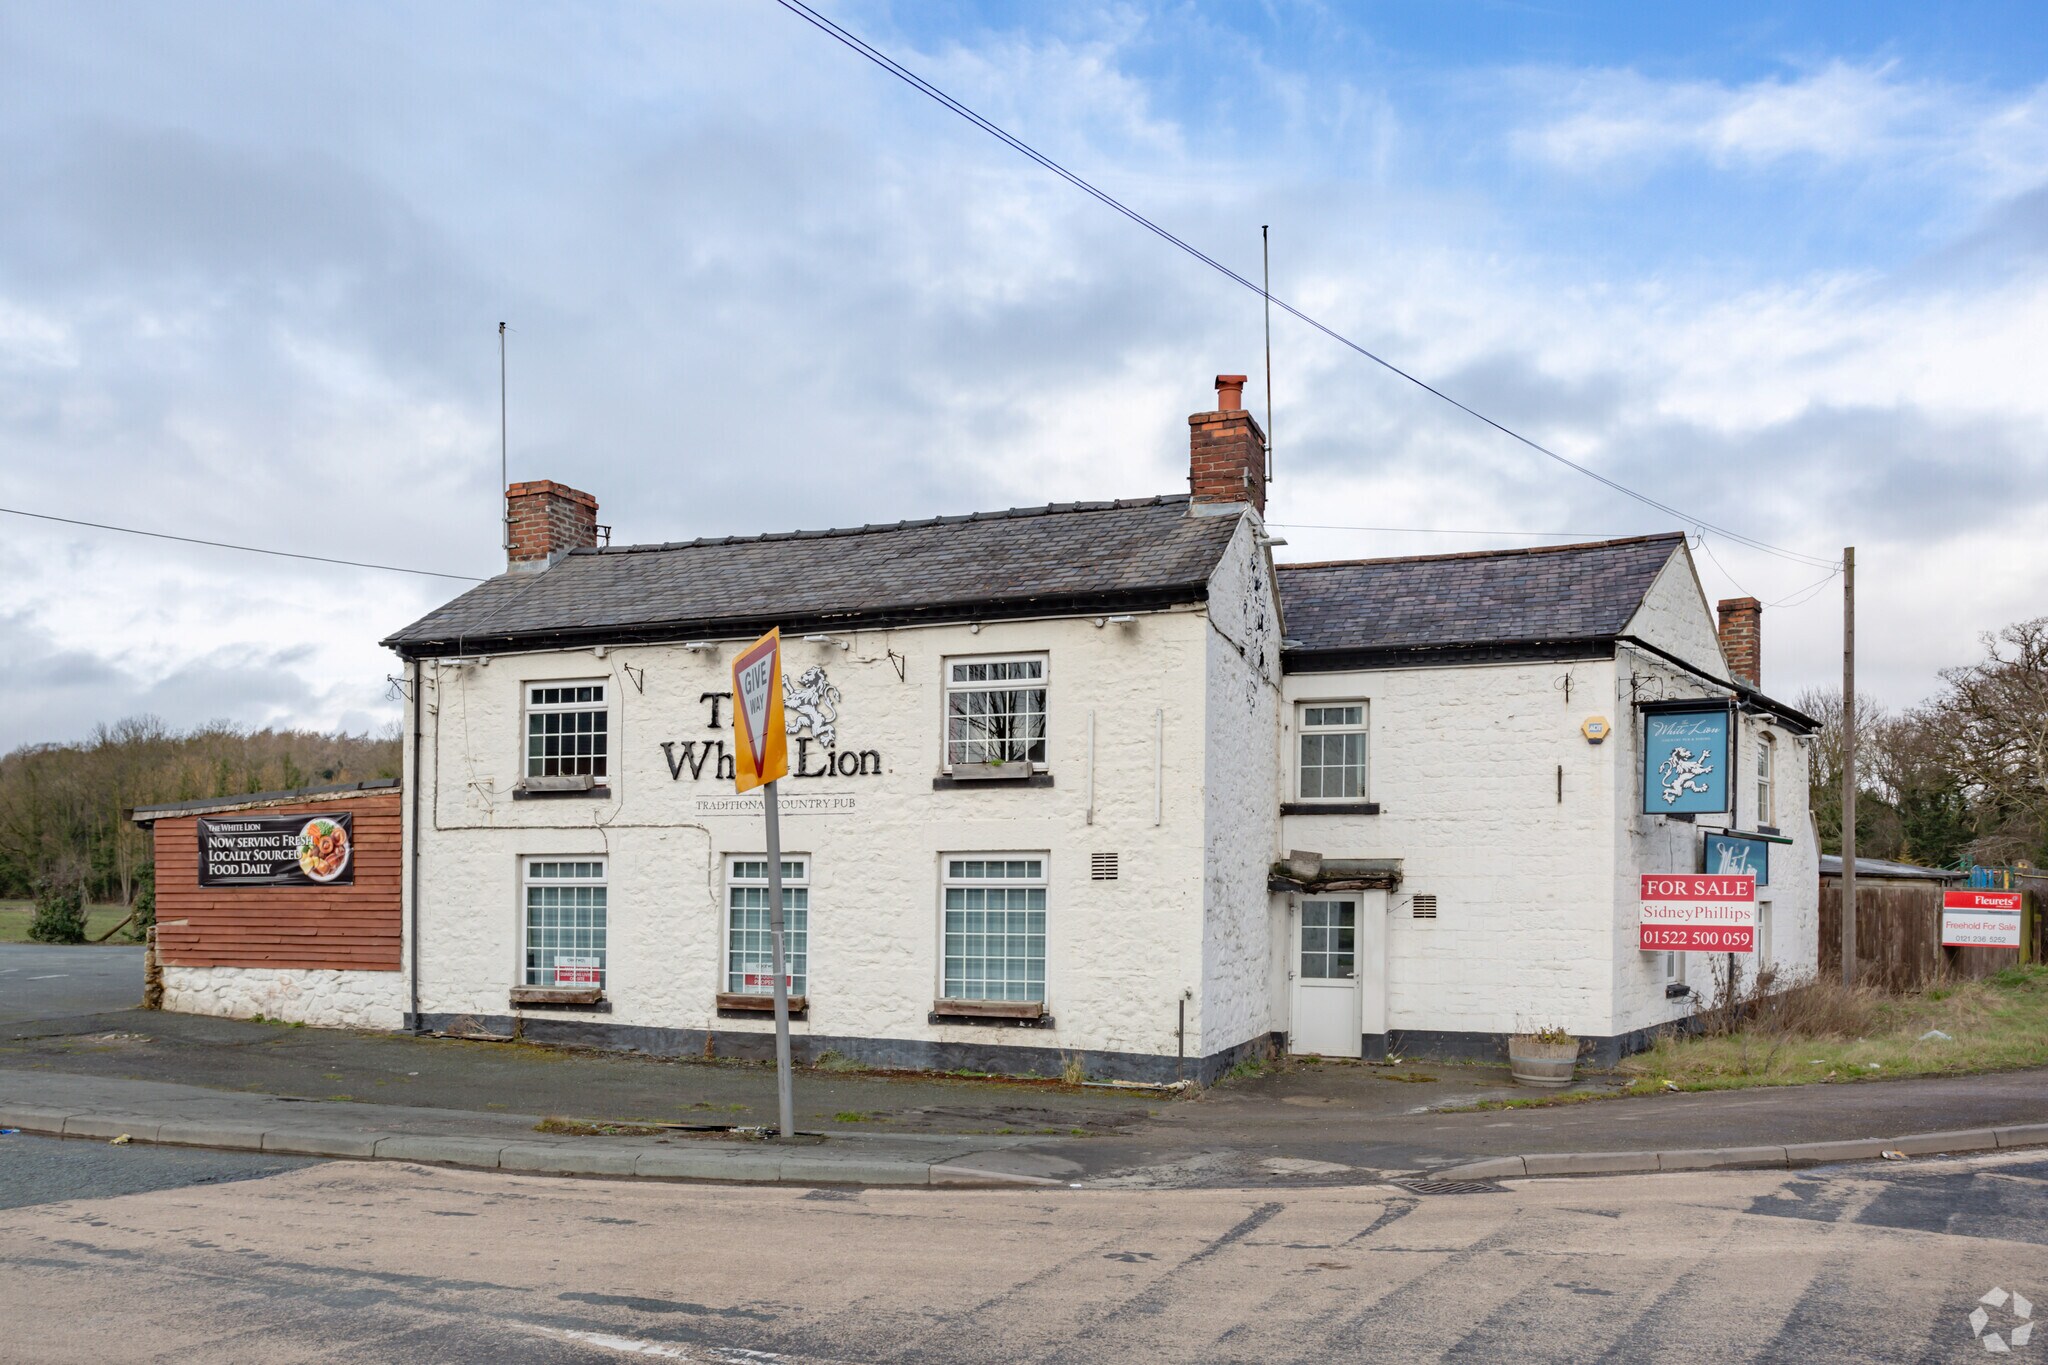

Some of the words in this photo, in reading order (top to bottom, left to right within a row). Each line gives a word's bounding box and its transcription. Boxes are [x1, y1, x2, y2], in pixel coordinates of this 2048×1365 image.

[744, 660, 768, 695] GIVE
[750, 693, 764, 715] WAY
[1652, 721, 1689, 737] White
[1688, 719, 1720, 735] Lion
[793, 736, 882, 779] Lion
[696, 800, 765, 811] TRADITIONA
[833, 797, 856, 809] PUB
[208, 824, 220, 832] THE
[220, 823, 243, 832] WHITE
[244, 823, 261, 831] LION
[208, 836, 236, 848] NOW
[237, 836, 280, 848] SERVING
[282, 834, 314, 847] FRESH
[208, 849, 252, 862] LOCALLY
[253, 849, 302, 861] SOURCED
[208, 863, 239, 875] FOOD
[241, 862, 272, 875] DAILY
[1646, 880, 1688, 896] FOR
[1694, 880, 1748, 896] SALE
[1975, 895, 2014, 906] Fleurets
[1945, 920, 1980, 930] Freehold
[1983, 922, 1996, 931] For
[1998, 923, 2016, 932] Sale
[1643, 930, 1688, 944] 01522
[1692, 931, 1719, 945] 500
[1722, 932, 1750, 946] 059
[1973, 935, 1986, 943] 236
